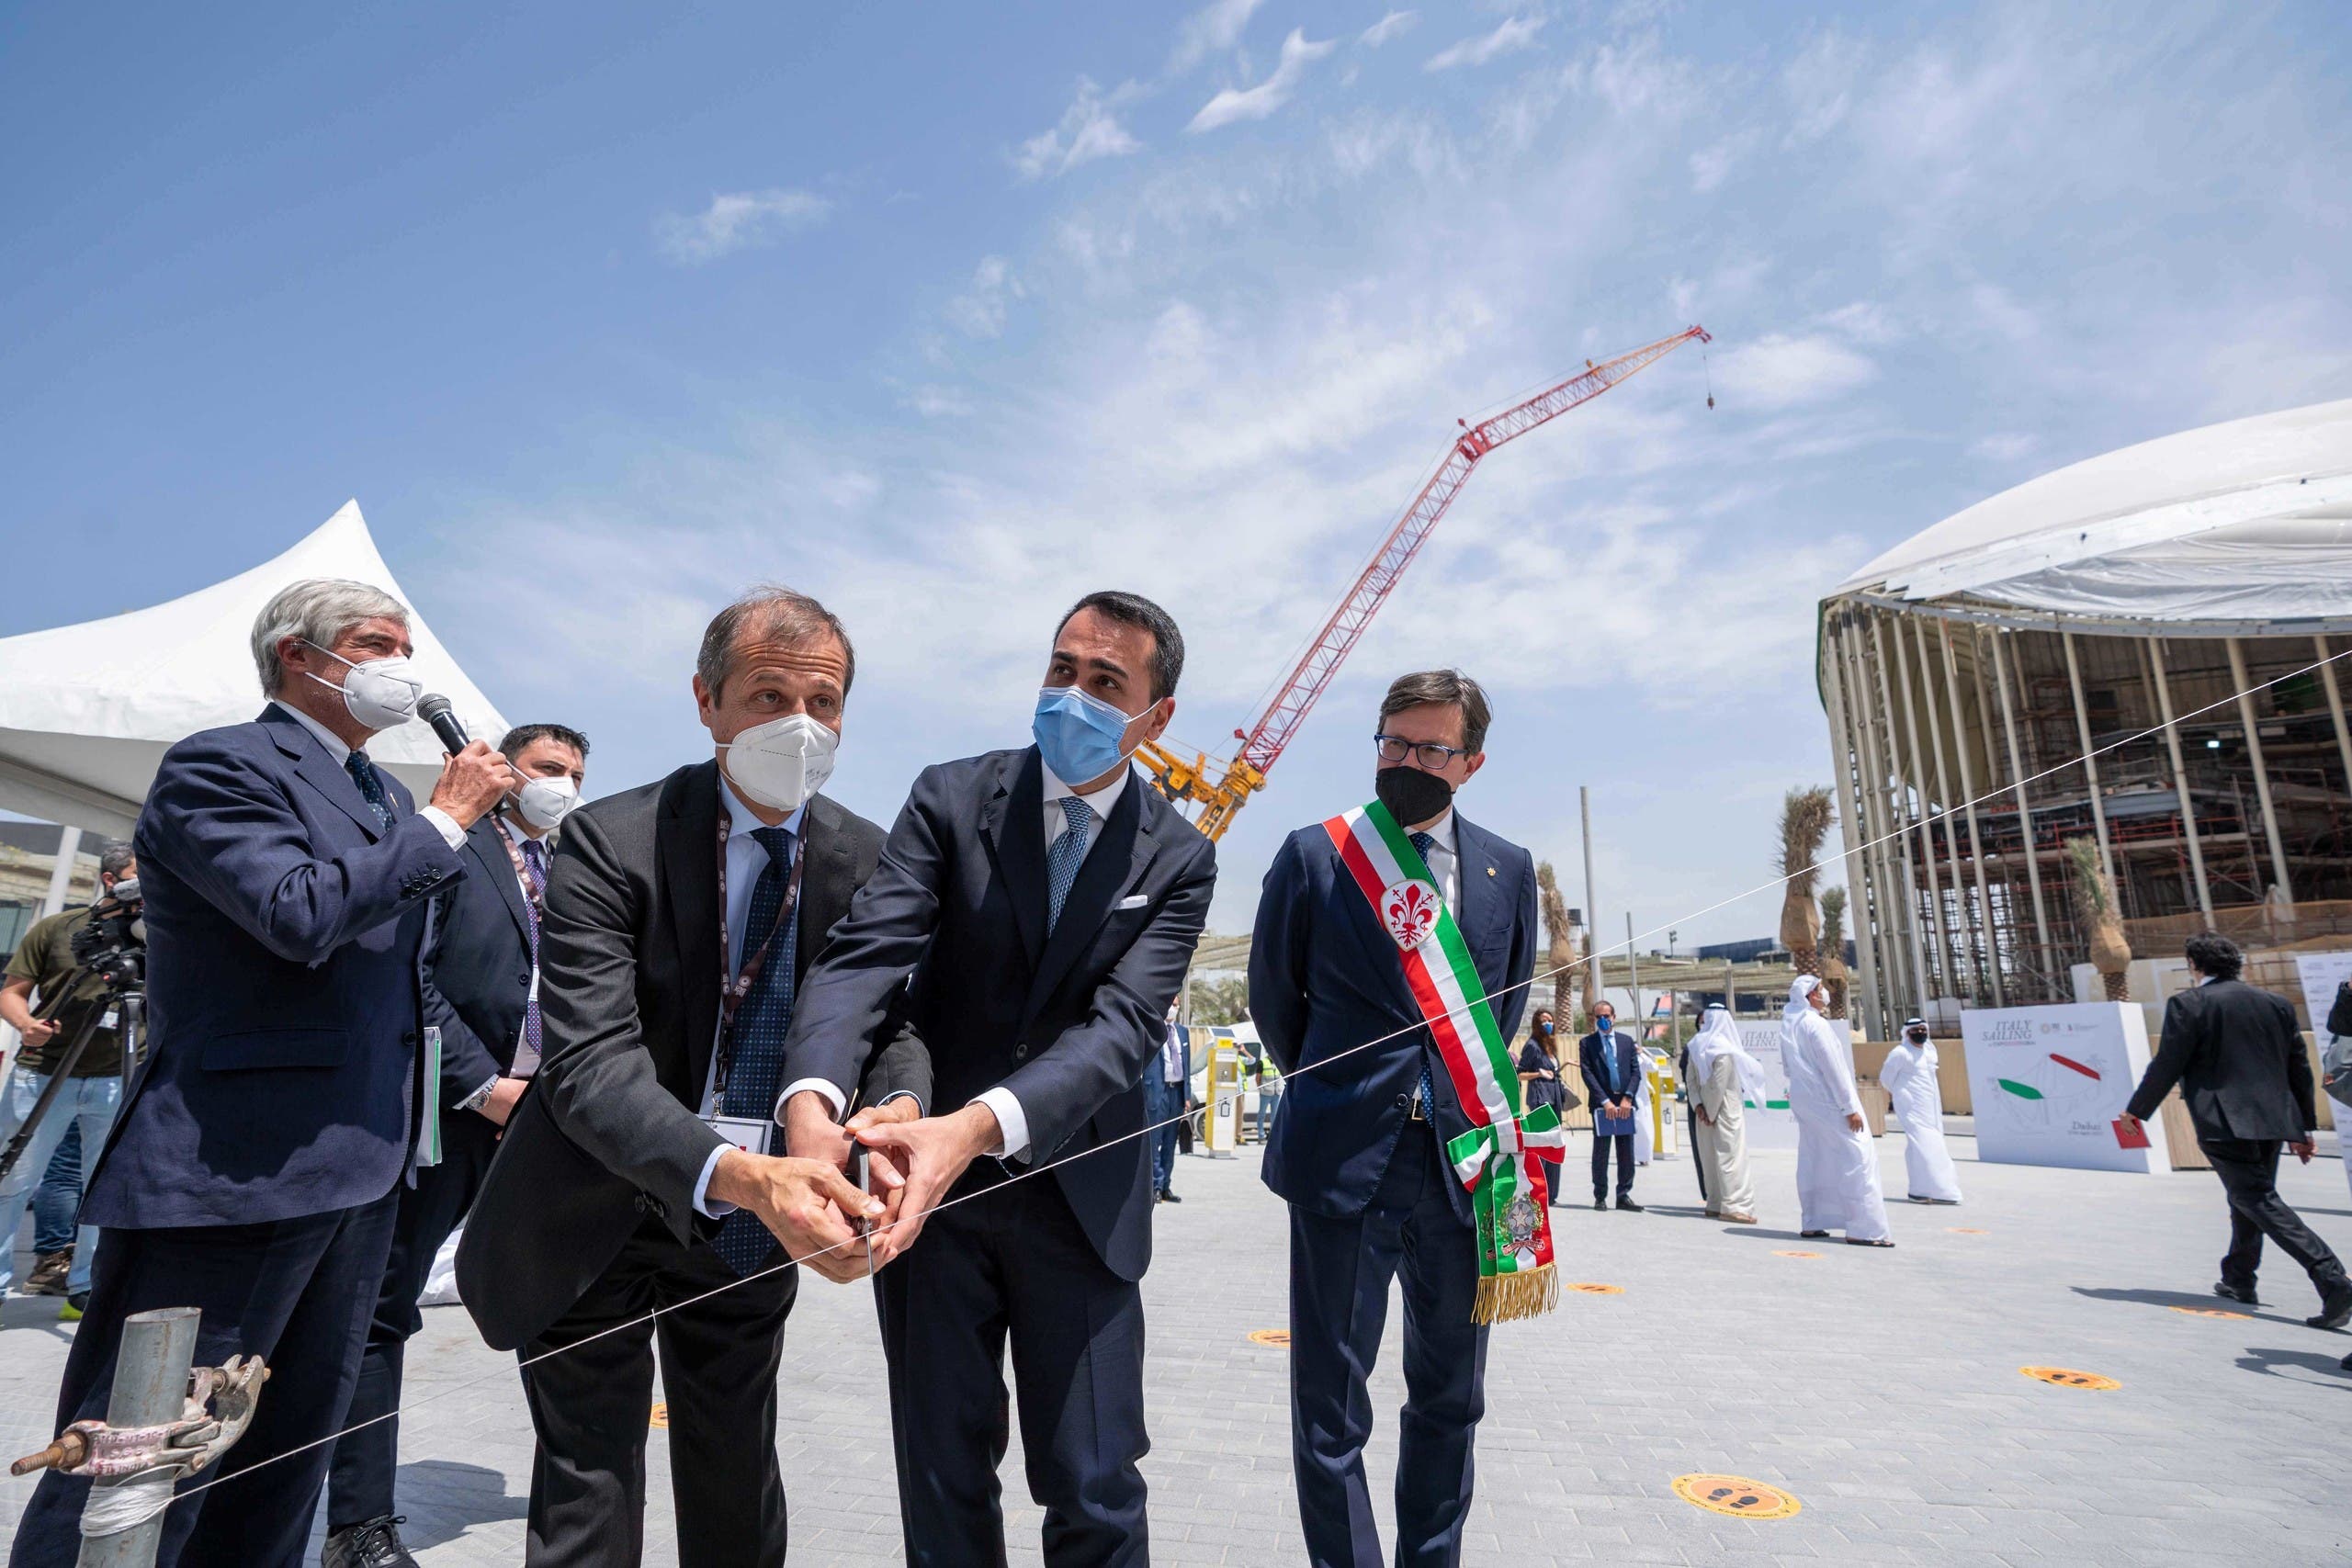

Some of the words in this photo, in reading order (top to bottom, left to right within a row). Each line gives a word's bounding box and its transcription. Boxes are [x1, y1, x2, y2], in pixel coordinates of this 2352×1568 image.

[1996, 1020, 2032, 1030] ITALY
[1746, 1030, 1778, 1039] ITALY
[1982, 1030, 2032, 1041] SAILING
